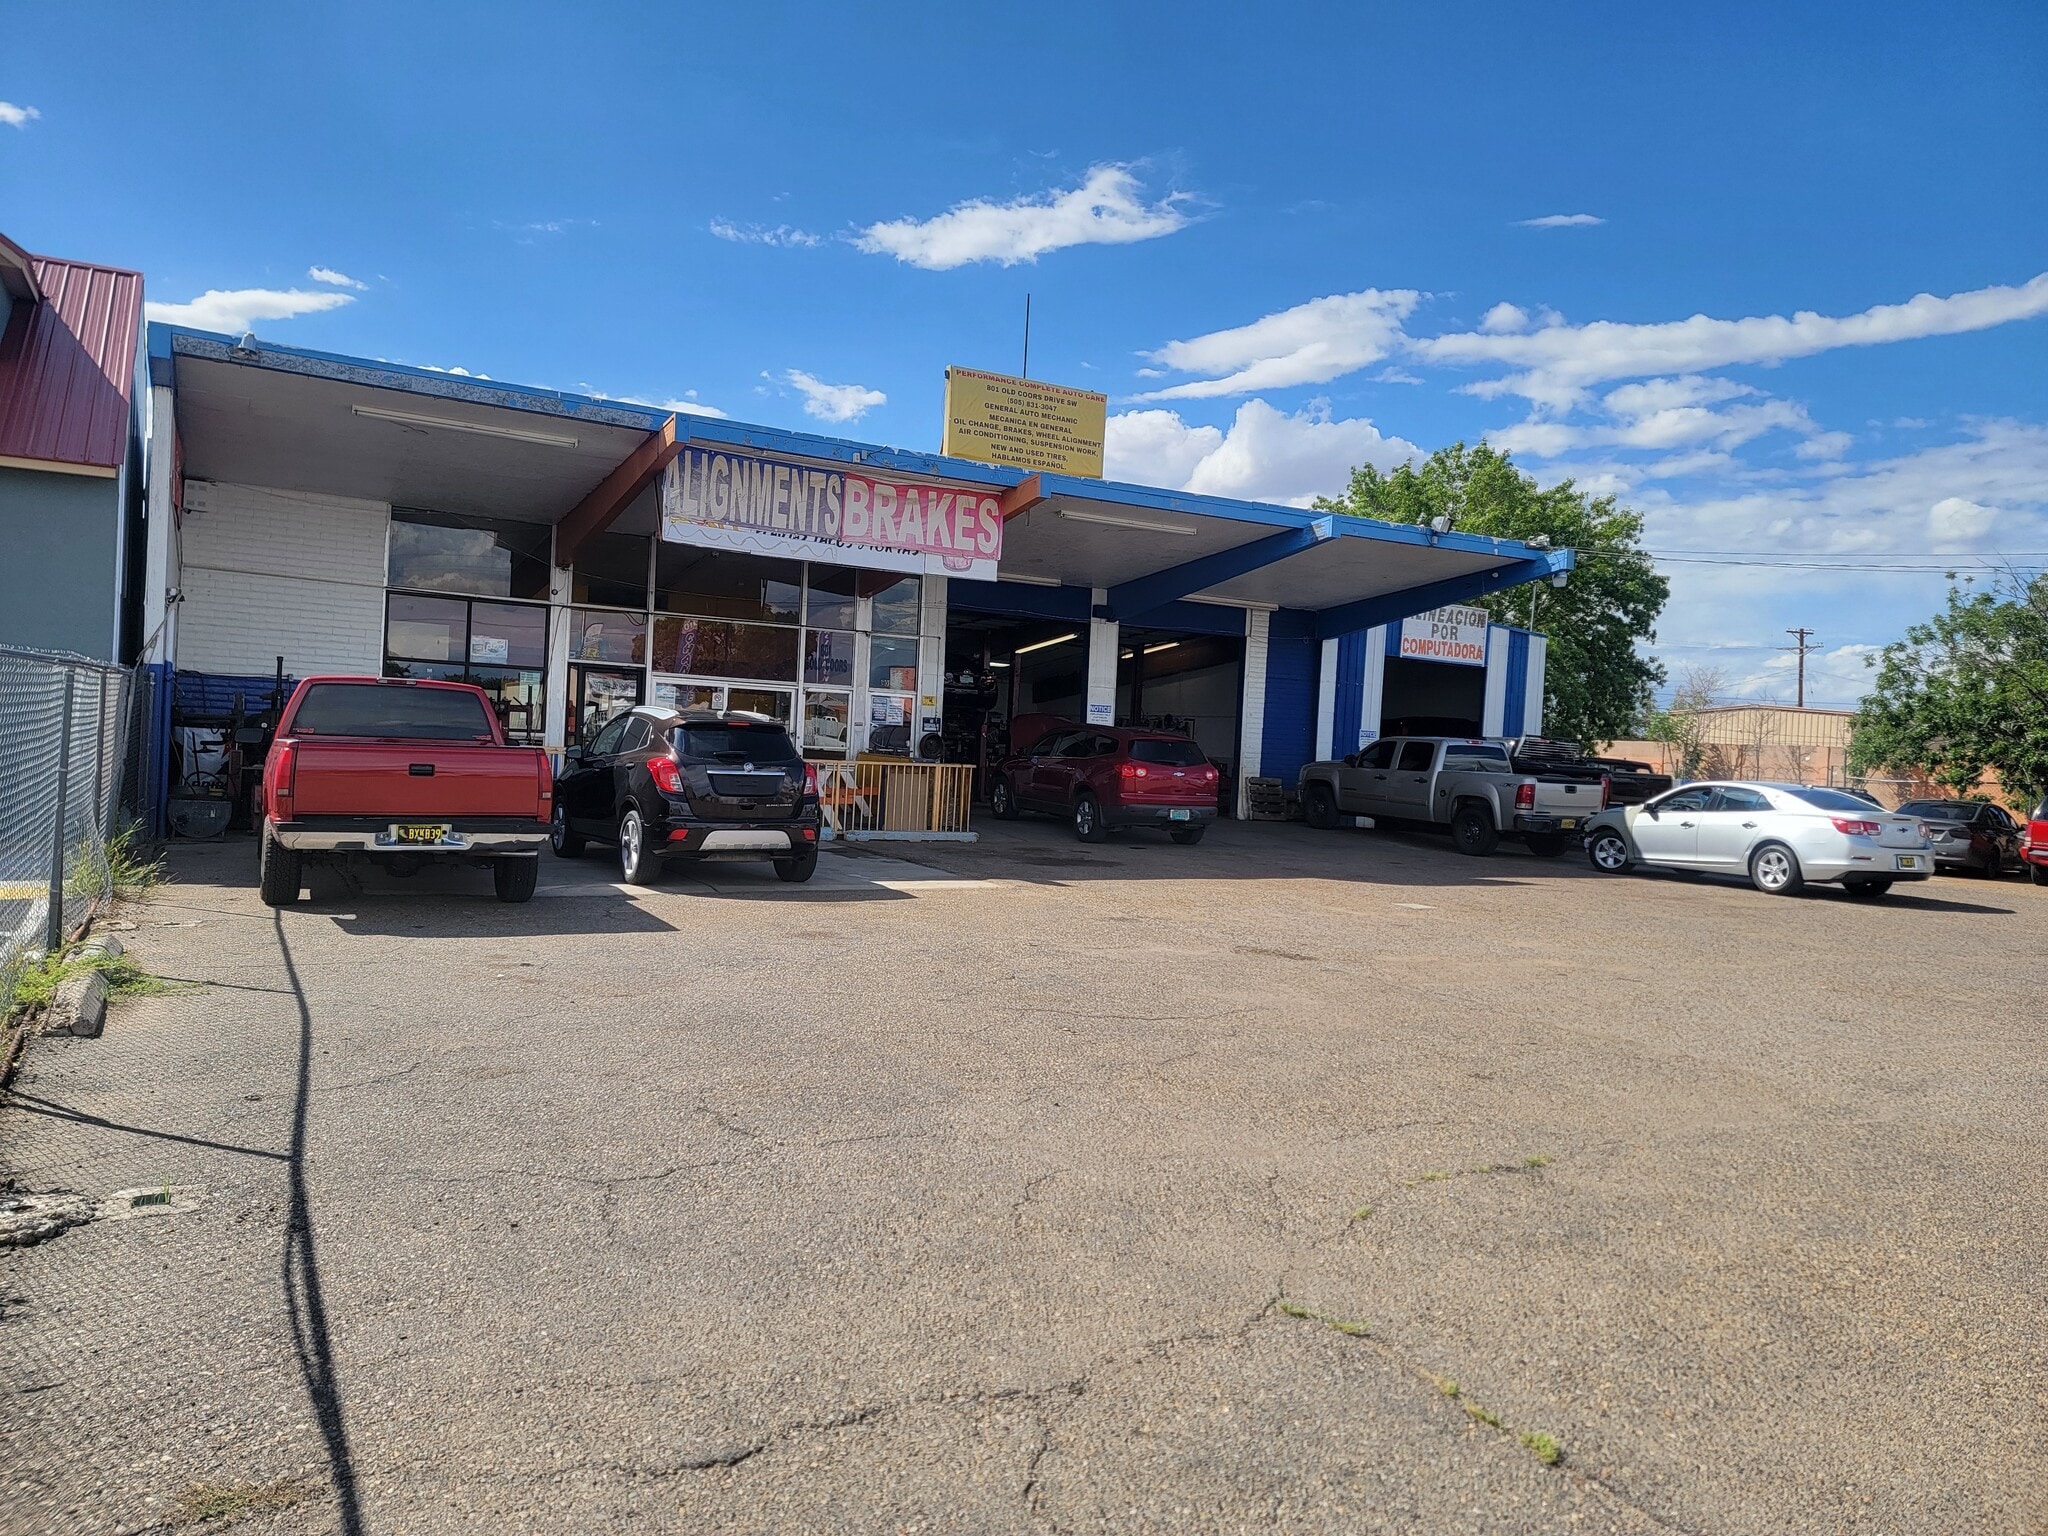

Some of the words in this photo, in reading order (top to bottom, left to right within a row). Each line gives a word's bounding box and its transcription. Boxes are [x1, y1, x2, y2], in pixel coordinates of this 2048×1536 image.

[956, 369, 1017, 386] PERFORMANCE
[1019, 380, 1061, 394] COMPLETE
[1062, 389, 1084, 398] AUTO
[1085, 393, 1105, 403] CARE
[986, 384, 1000, 393] 801
[1001, 387, 1016, 396] OLD
[1018, 390, 1043, 401] COORS
[1044, 395, 1065, 405] DRIVE
[1066, 399, 1078, 408] SW
[984, 402, 1018, 414] GENERAL
[1019, 408, 1039, 418] AUTO
[1041, 412, 1078, 425] MECHANIC
[1007, 397, 1025, 407] (505)
[1026, 401, 1057, 412] 831-3047
[953, 417, 967, 426] OIL
[968, 420, 1002, 432] CHANGE,
[1003, 425, 1034, 437] BRAKES,
[1036, 430, 1060, 440] WHEEL
[1061, 435, 1103, 450] ALIGNMENT,
[989, 414, 1027, 427] MECANICA
[1040, 422, 1072, 434] GENERAL
[958, 427, 972, 435] AIR
[974, 430, 1029, 445] CONDITIONING,
[1030, 439, 1075, 452] SUSPENSION
[1076, 447, 1099, 457] WORK,
[991, 443, 1008, 451] NEW
[1009, 446, 1024, 454] AND
[1026, 448, 1045, 457] USED
[1046, 452, 1068, 462] TIRES,
[991, 453, 1031, 465] HABLAMOS
[664, 450, 841, 536] ALIGNMENTS
[845, 479, 999, 554] BRAKES
[1411, 608, 1486, 628] LINEACION
[1431, 623, 1458, 641] POR
[1402, 637, 1483, 660] COMPUTADORA
[1090, 705, 1112, 713] NOTICE
